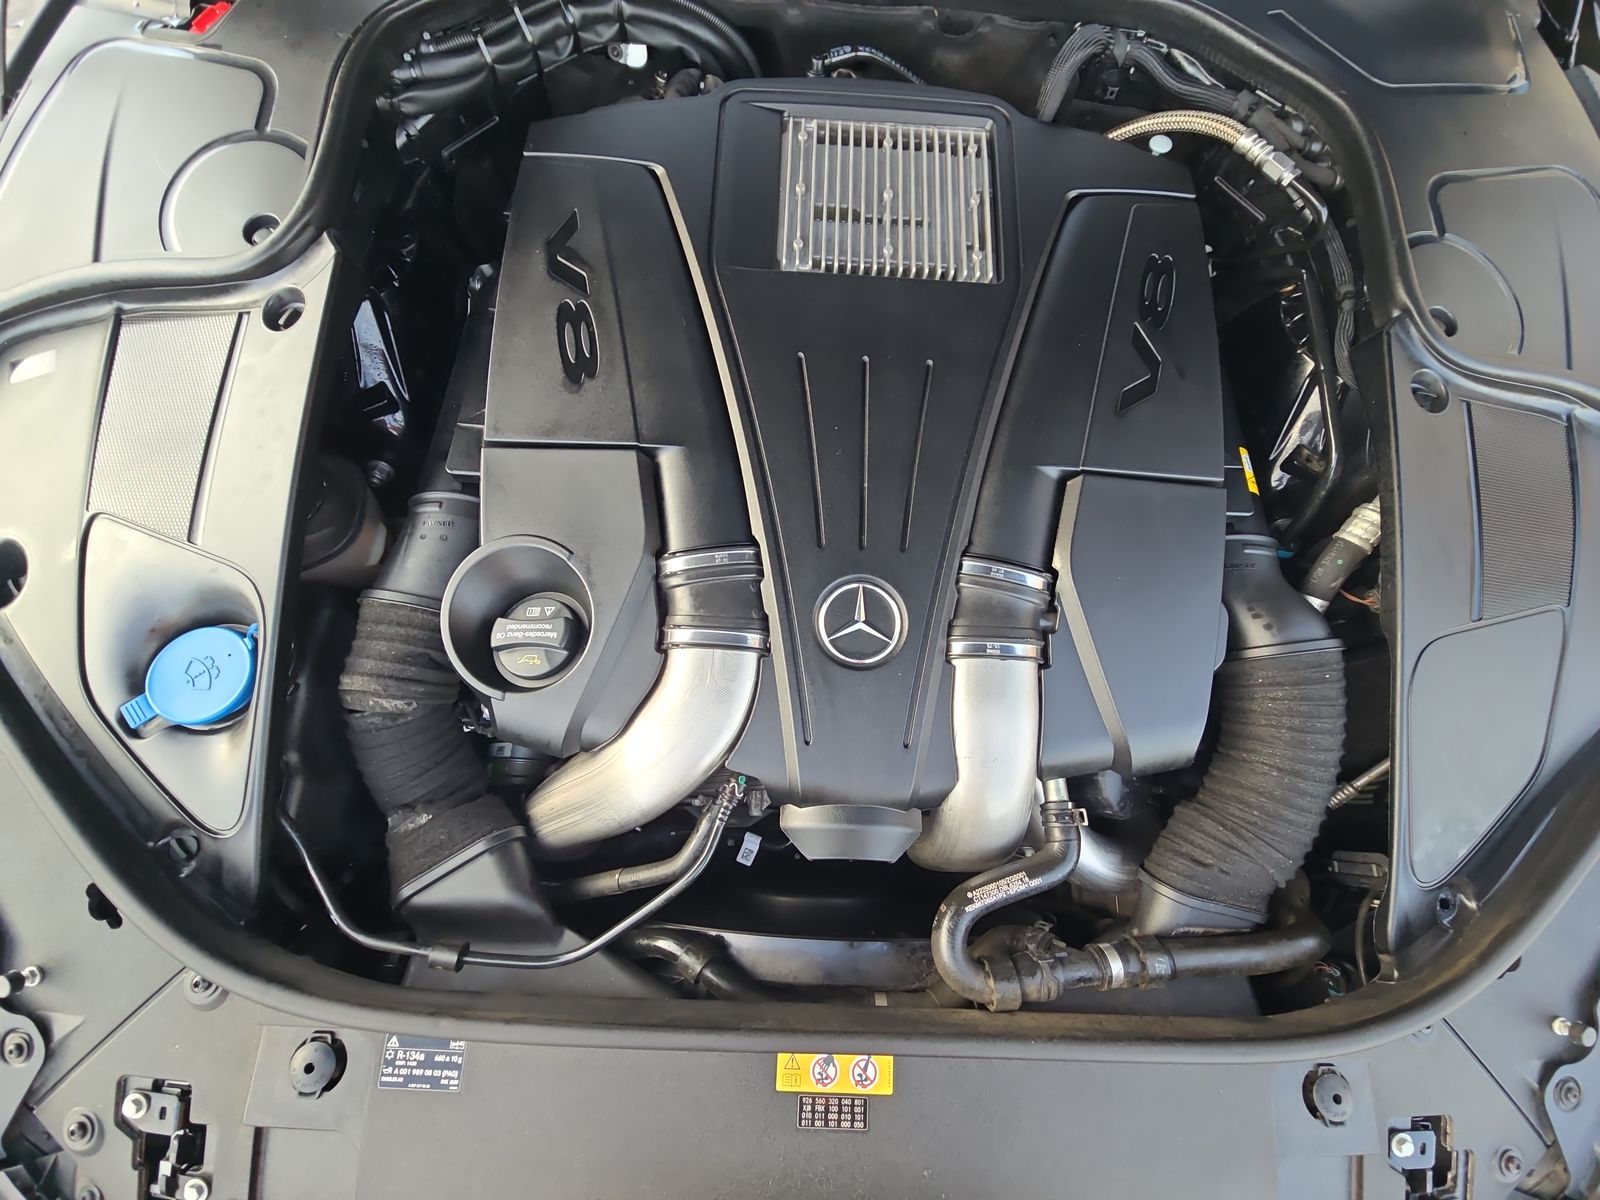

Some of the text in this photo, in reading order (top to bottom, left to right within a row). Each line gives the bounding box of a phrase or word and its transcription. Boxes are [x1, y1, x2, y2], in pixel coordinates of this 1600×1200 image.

[546, 208, 600, 385] V8
[1116, 252, 1177, 413] V8
[506, 623, 553, 631] recommended
[496, 631, 558, 640] Mercedes-Benz Oil
[396, 1050, 425, 1061] R-134a
